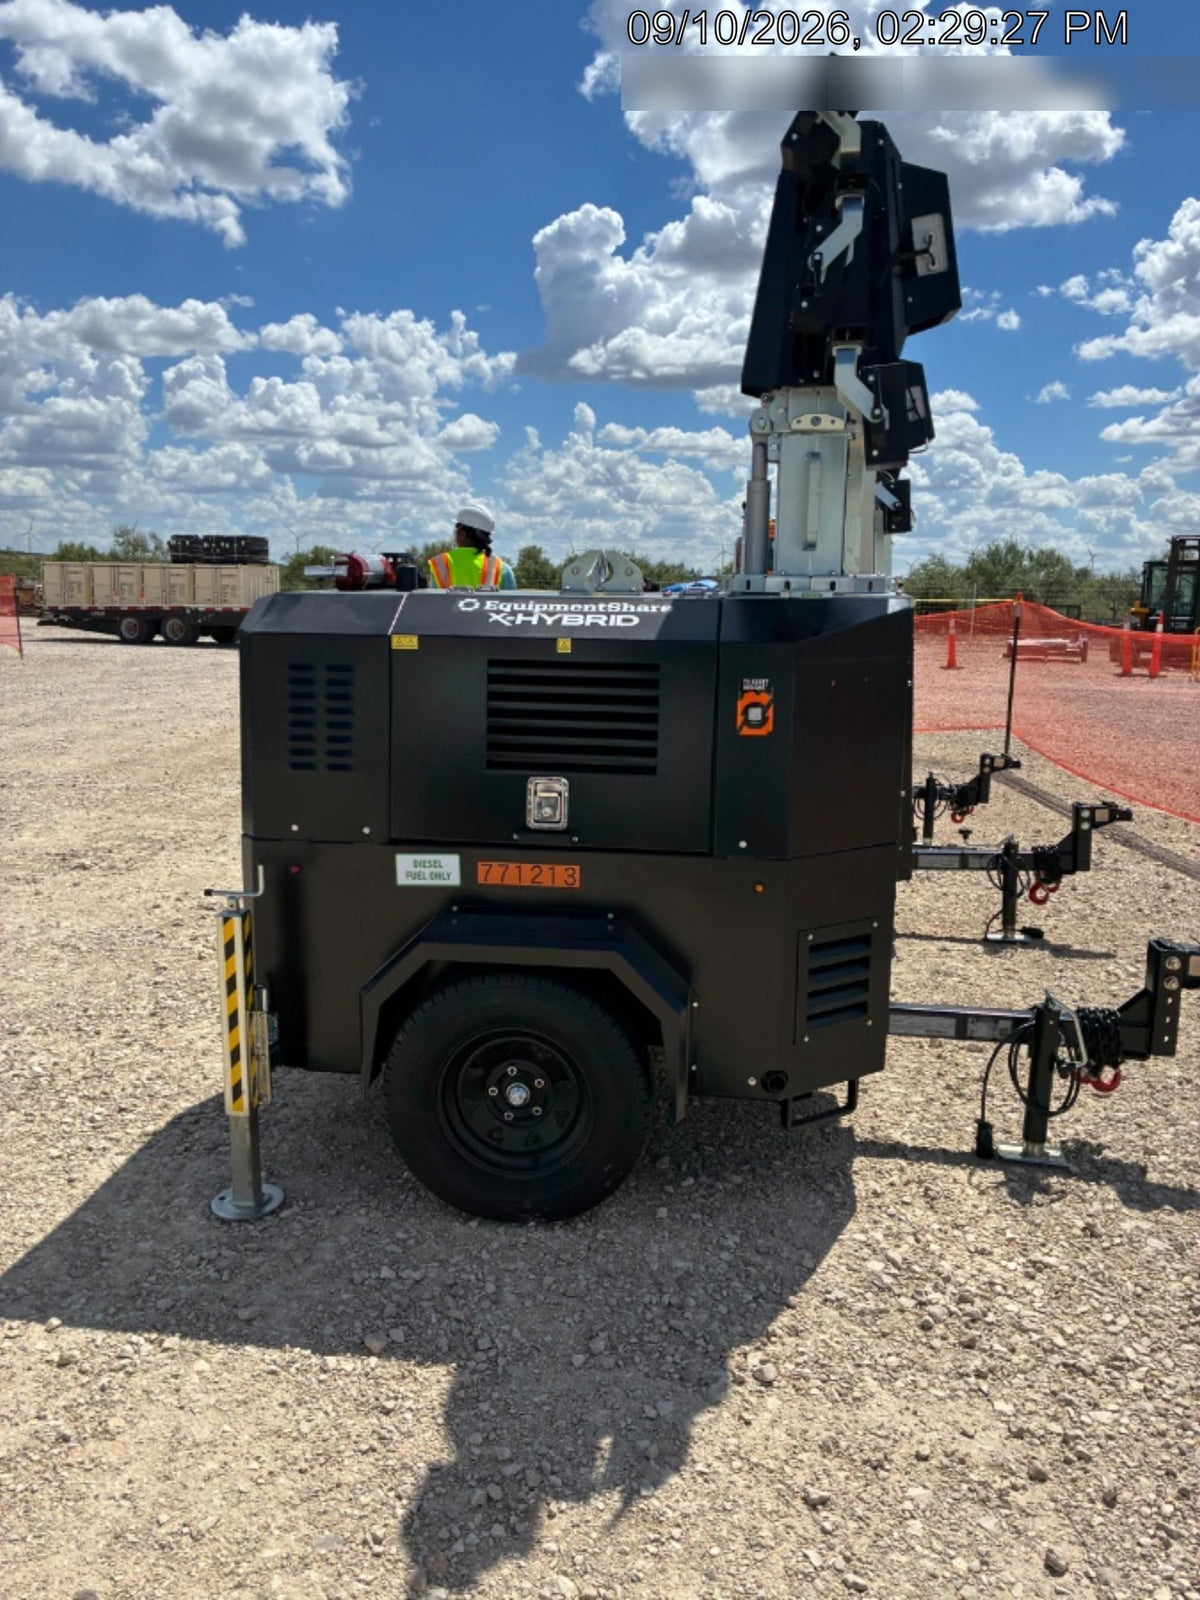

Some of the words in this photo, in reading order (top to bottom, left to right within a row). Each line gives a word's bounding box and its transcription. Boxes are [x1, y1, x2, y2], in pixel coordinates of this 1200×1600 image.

[484, 599, 673, 614] EquipmentShare
[488, 612, 641, 627] X-HYBRID
[412, 859, 444, 869] DIESEL
[405, 871, 428, 881] FUEL
[429, 871, 451, 881] ONLY
[480, 863, 577, 887] 771213
